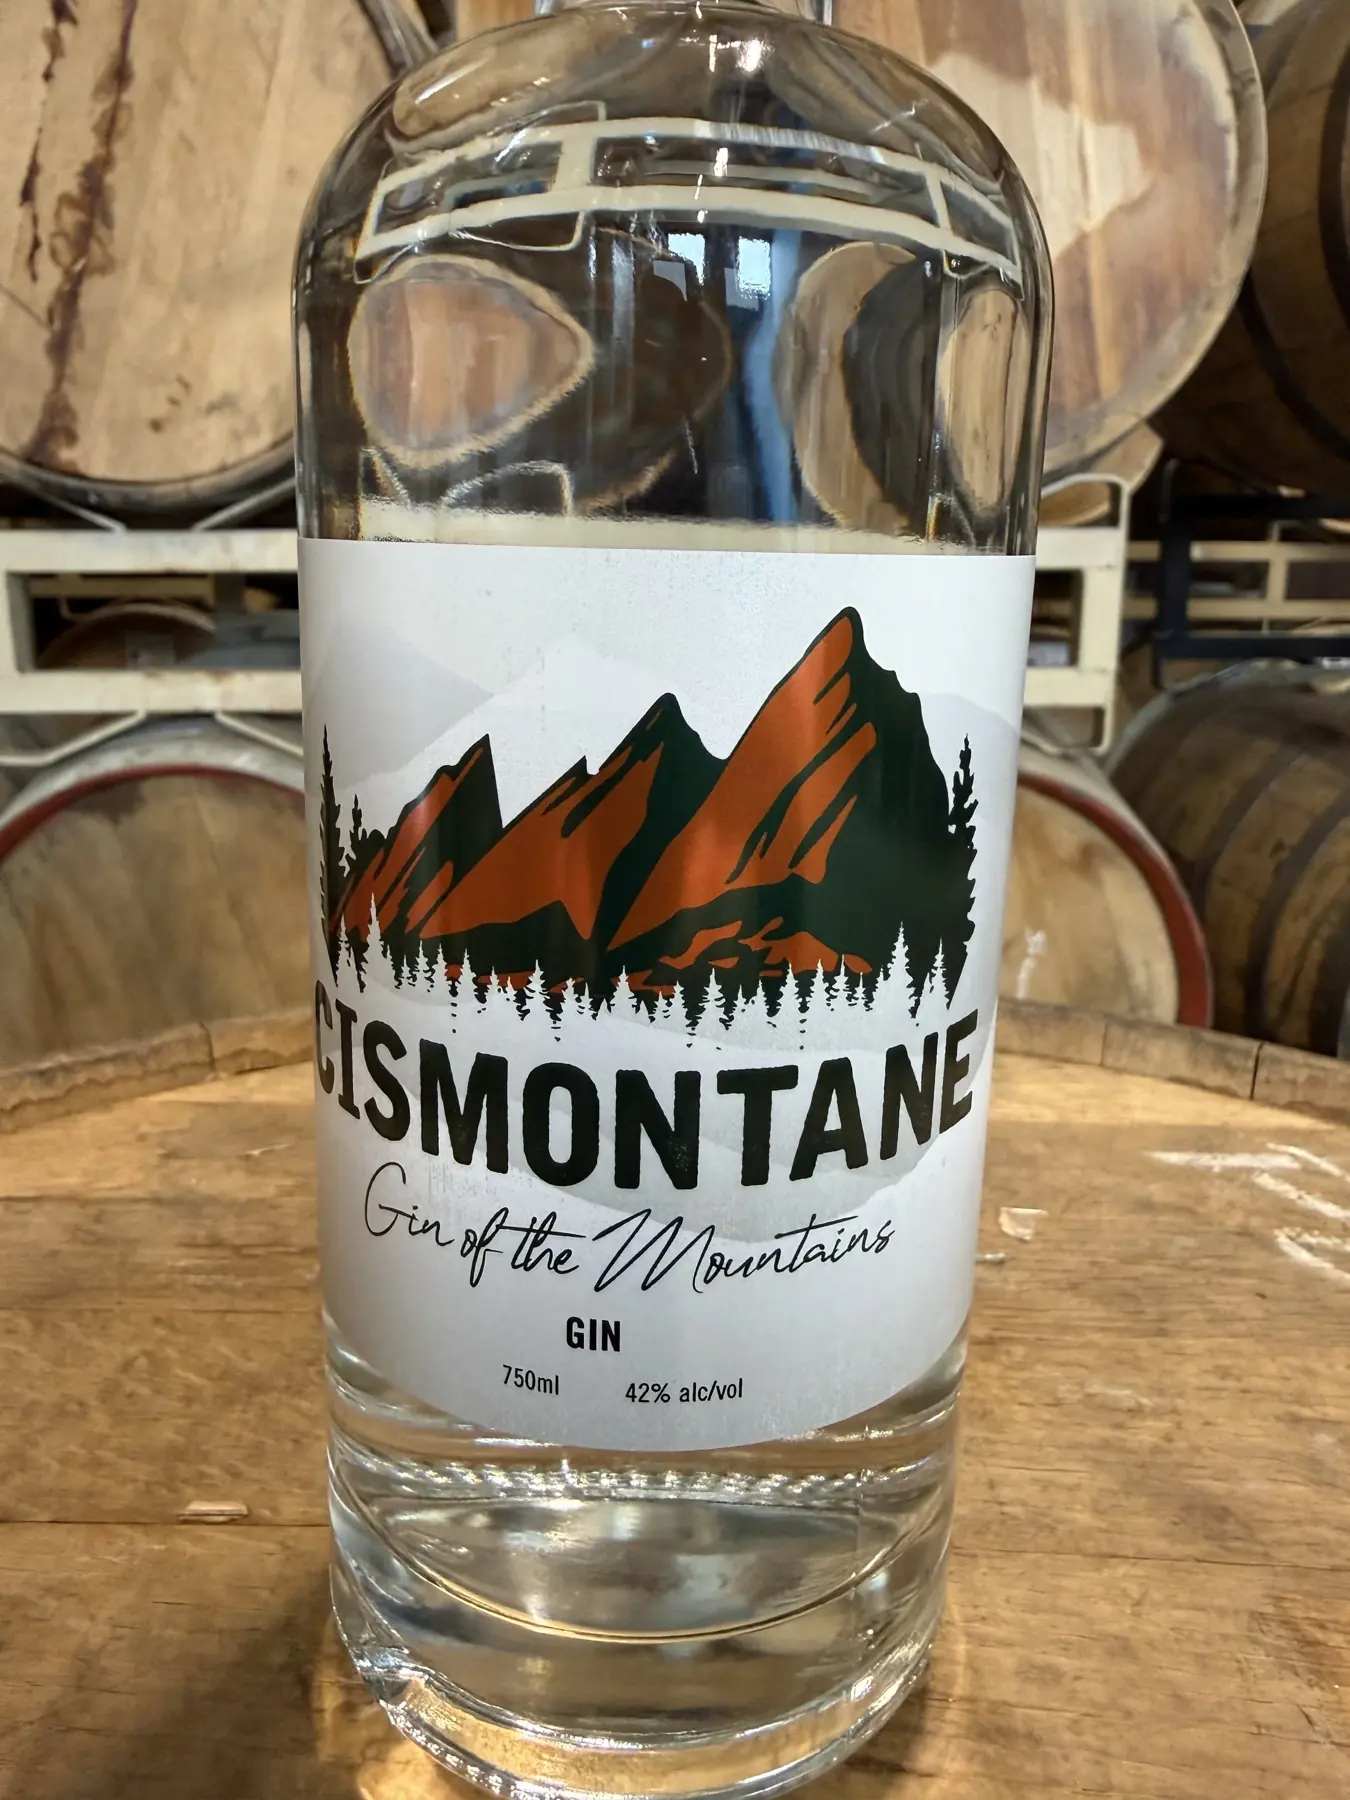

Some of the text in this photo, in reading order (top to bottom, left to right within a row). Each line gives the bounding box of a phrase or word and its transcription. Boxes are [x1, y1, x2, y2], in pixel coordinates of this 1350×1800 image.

[315, 980, 979, 1190] CISMONTANE
[365, 1162, 896, 1294] Gin of the Mountains
[566, 1316, 621, 1352] GIN
[502, 1364, 560, 1396] 750ml
[625, 1377, 744, 1404] 42% alc/vol
